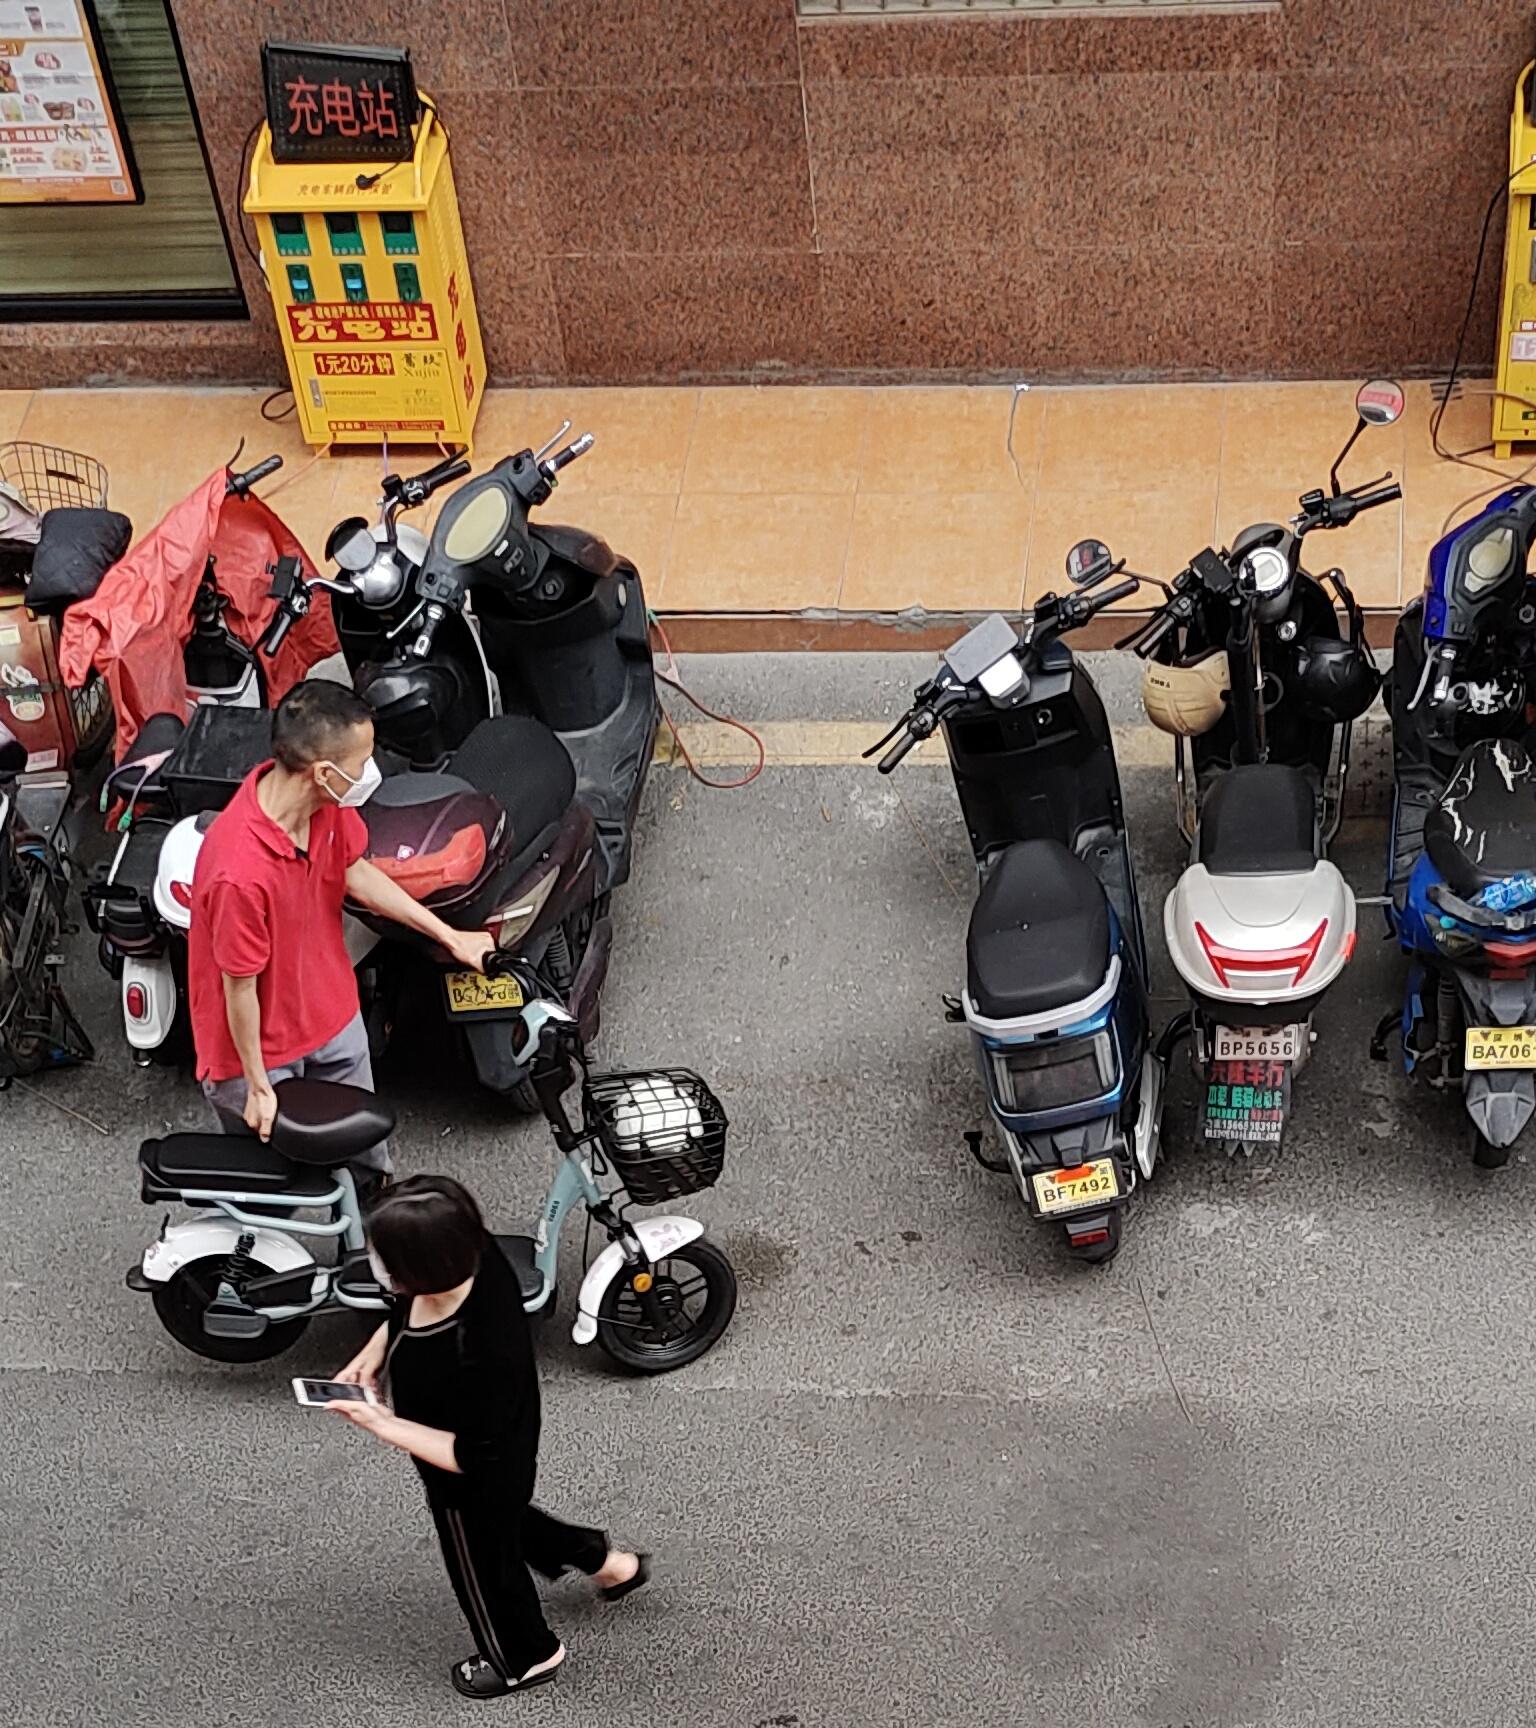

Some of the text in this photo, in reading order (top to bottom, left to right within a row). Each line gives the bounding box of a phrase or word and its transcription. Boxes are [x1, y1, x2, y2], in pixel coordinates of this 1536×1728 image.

[285, 74, 398, 138] 充电站
[292, 304, 433, 341] 充电站
[316, 355, 393, 376] 1元20分钟
[1220, 1041, 1293, 1056] BP5656
[1043, 1177, 1111, 1203] BF7492
